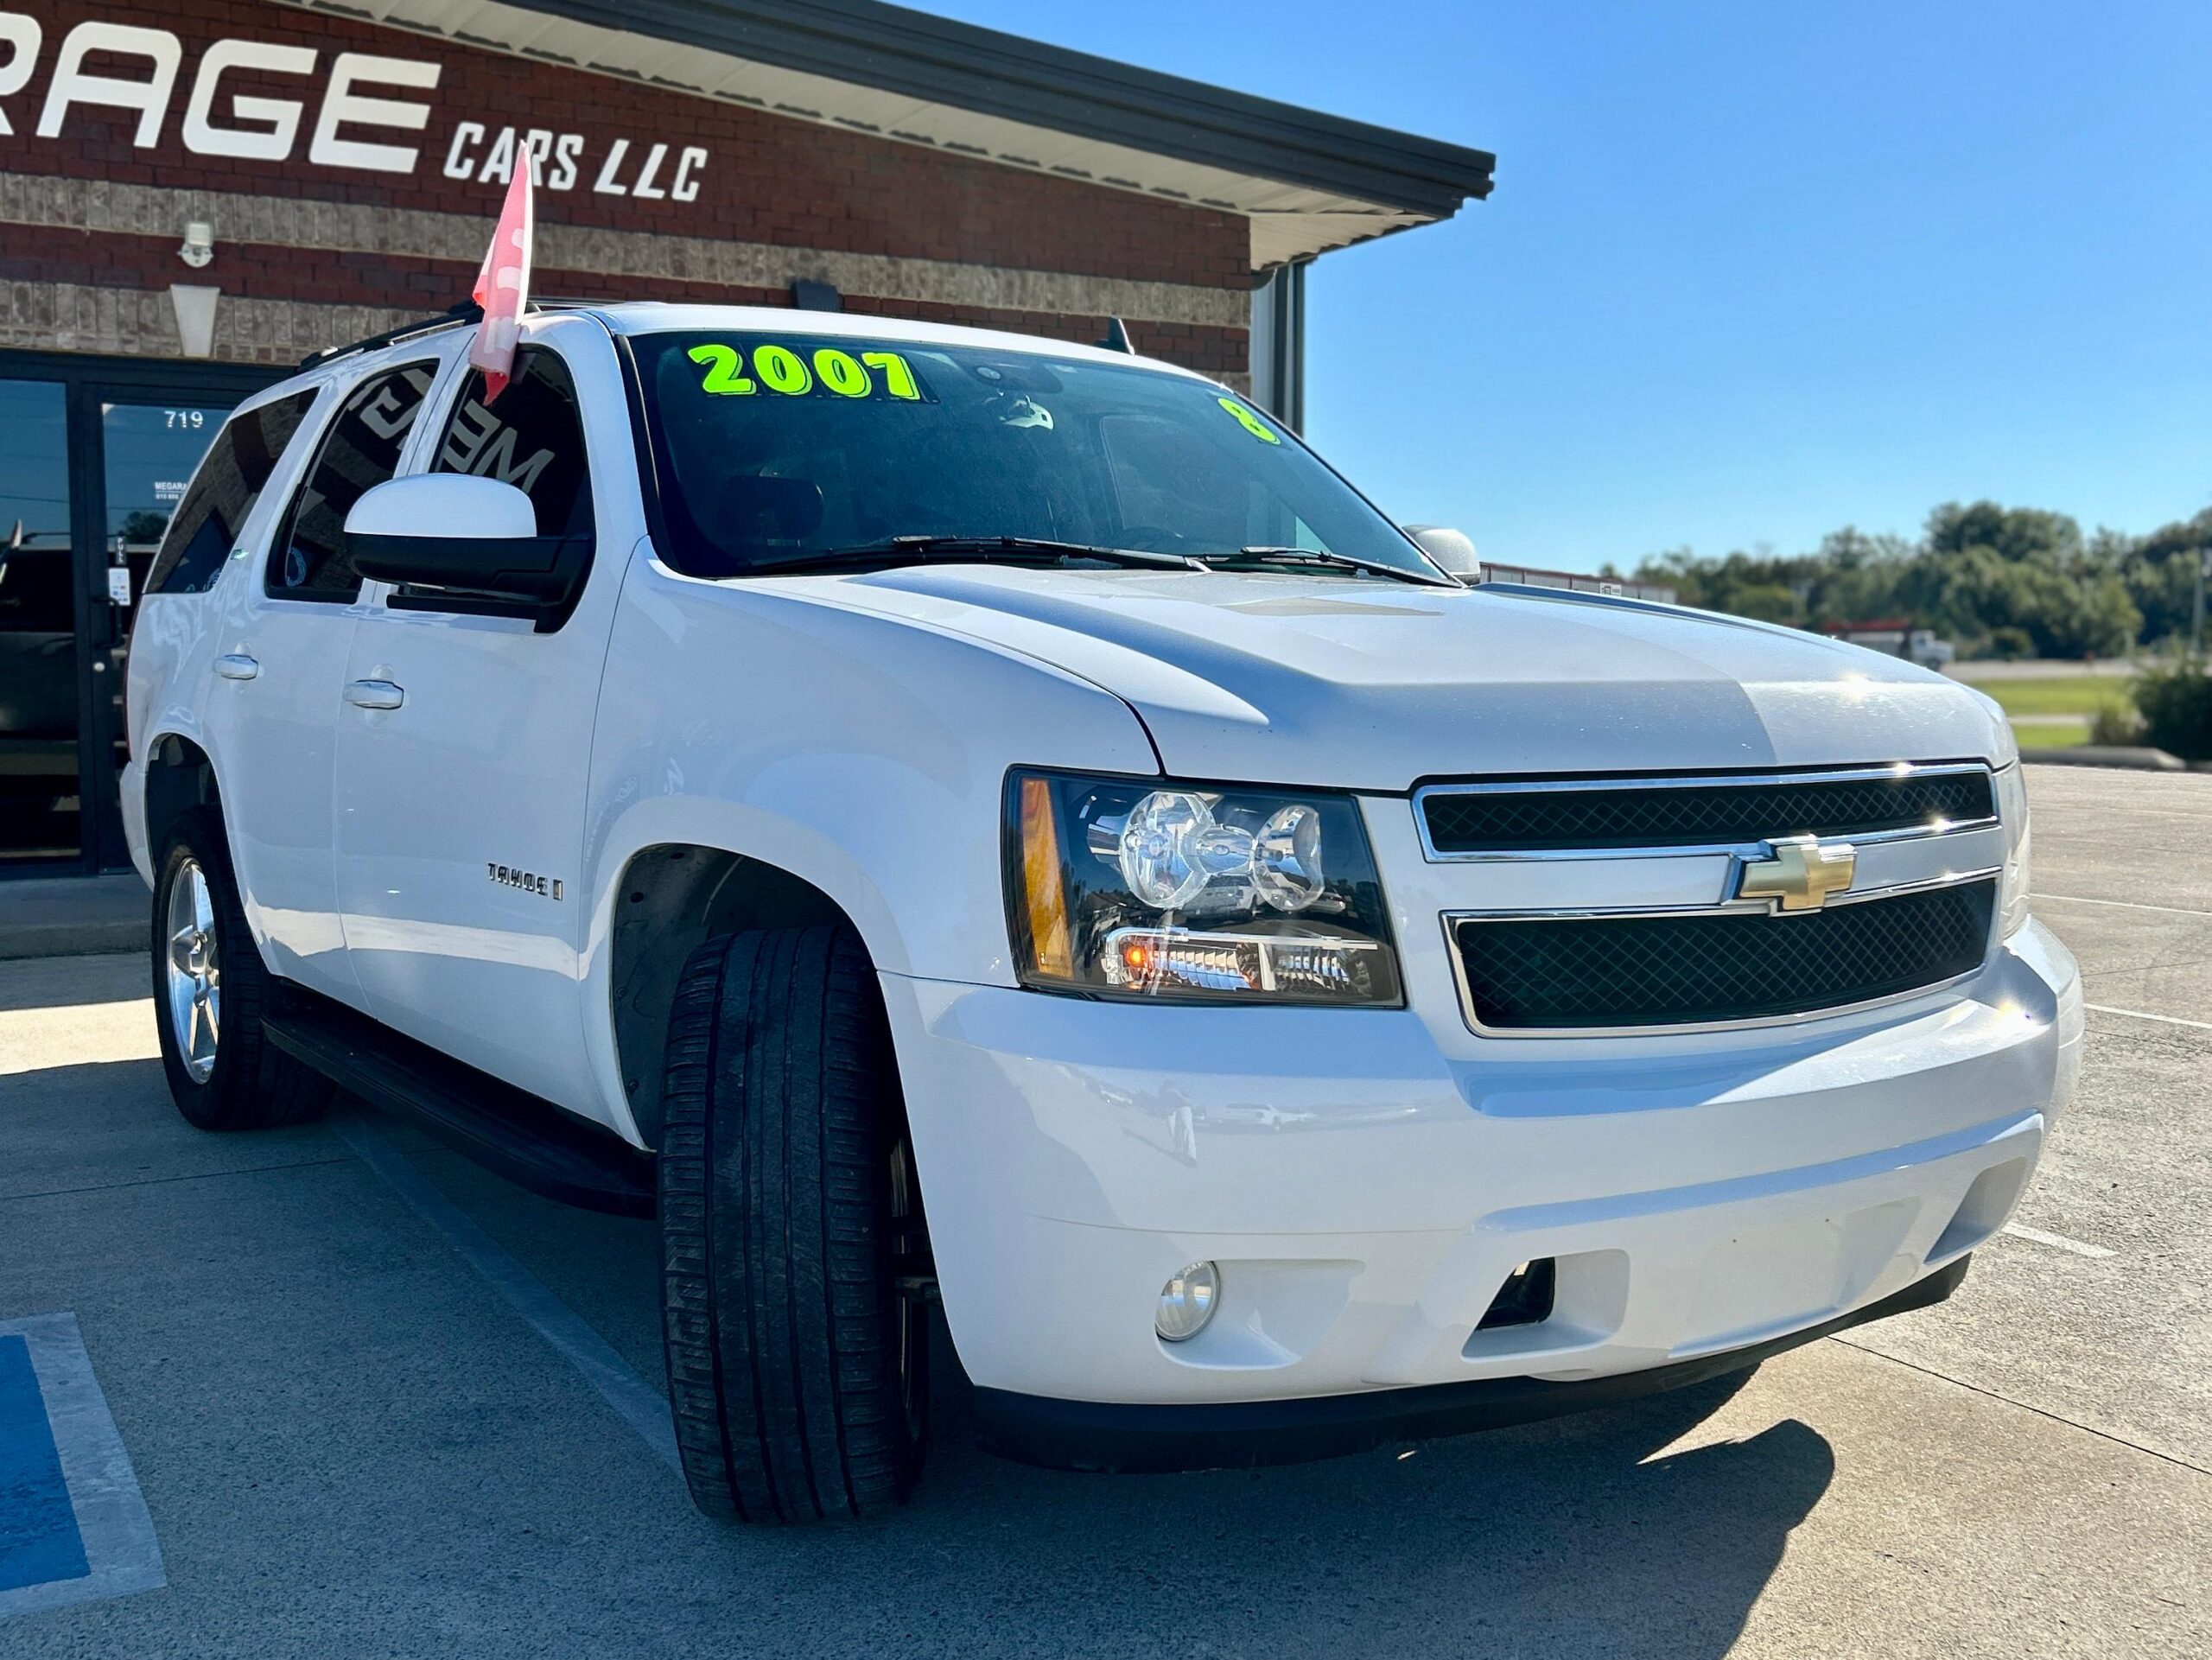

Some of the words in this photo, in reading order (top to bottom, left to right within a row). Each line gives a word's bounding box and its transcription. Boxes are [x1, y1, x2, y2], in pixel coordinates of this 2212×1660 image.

[443, 121, 584, 191] CARS
[593, 139, 708, 201] LLC
[688, 344, 920, 400] 2007
[164, 410, 203, 428] 719
[488, 862, 548, 896] TAHOE
